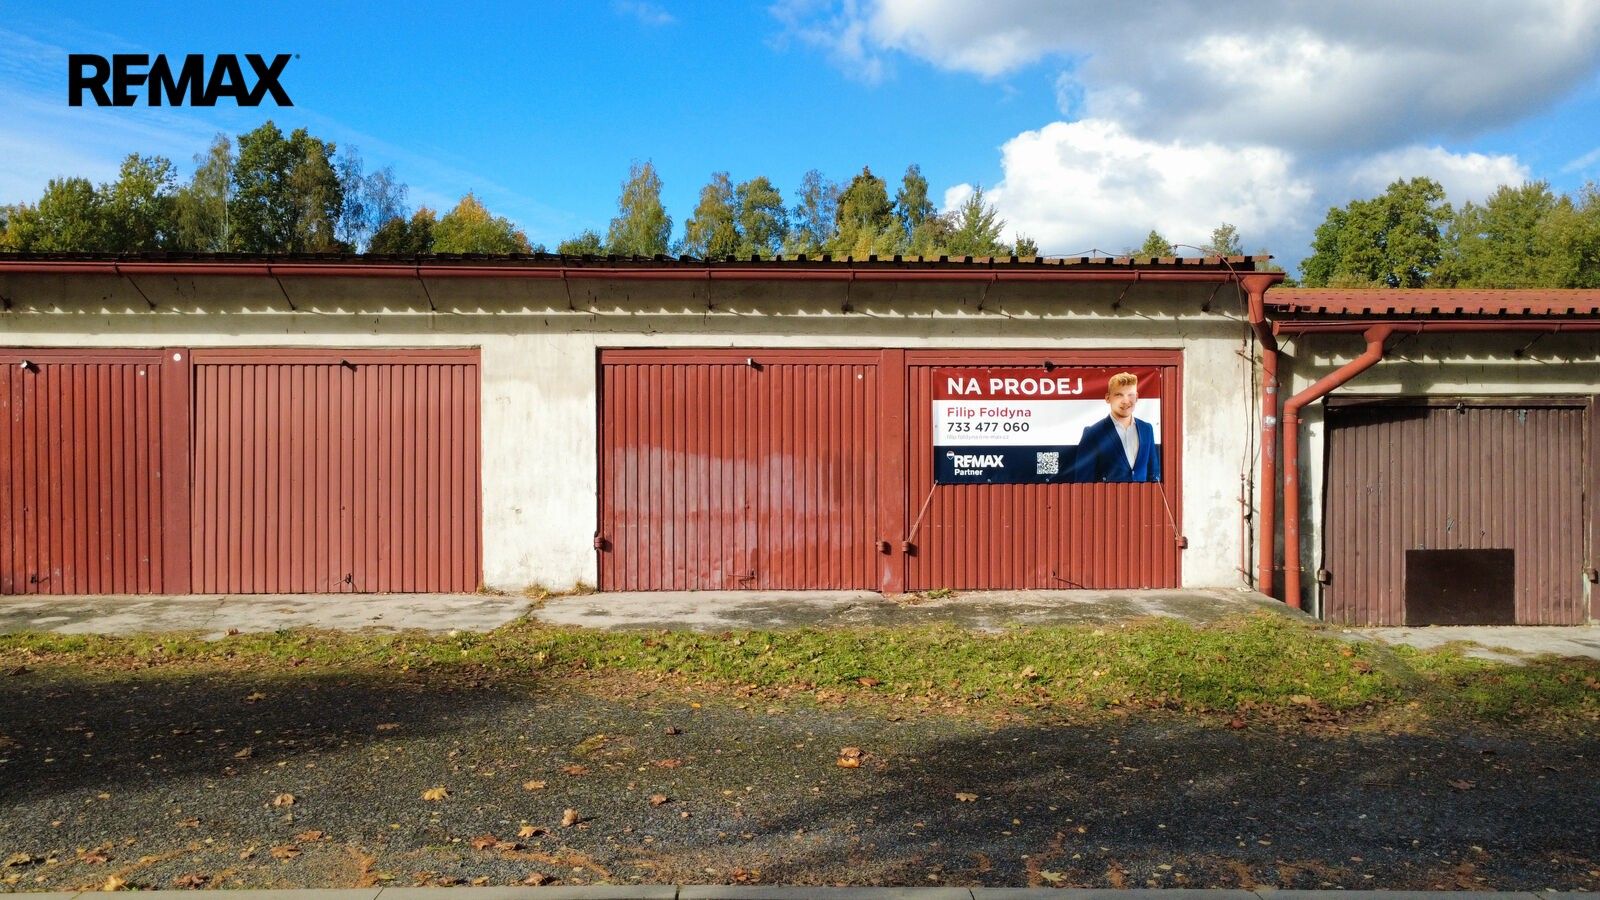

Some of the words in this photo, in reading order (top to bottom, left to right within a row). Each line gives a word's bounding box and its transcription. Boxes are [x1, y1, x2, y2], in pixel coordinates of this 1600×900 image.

[947, 378, 982, 395] NA
[990, 378, 1083, 395] PRODEJ
[947, 407, 976, 419] Filip
[980, 407, 1032, 419] Foldyna
[947, 422, 971, 432] 733
[975, 422, 999, 432] 477
[1003, 422, 1030, 432] 060
